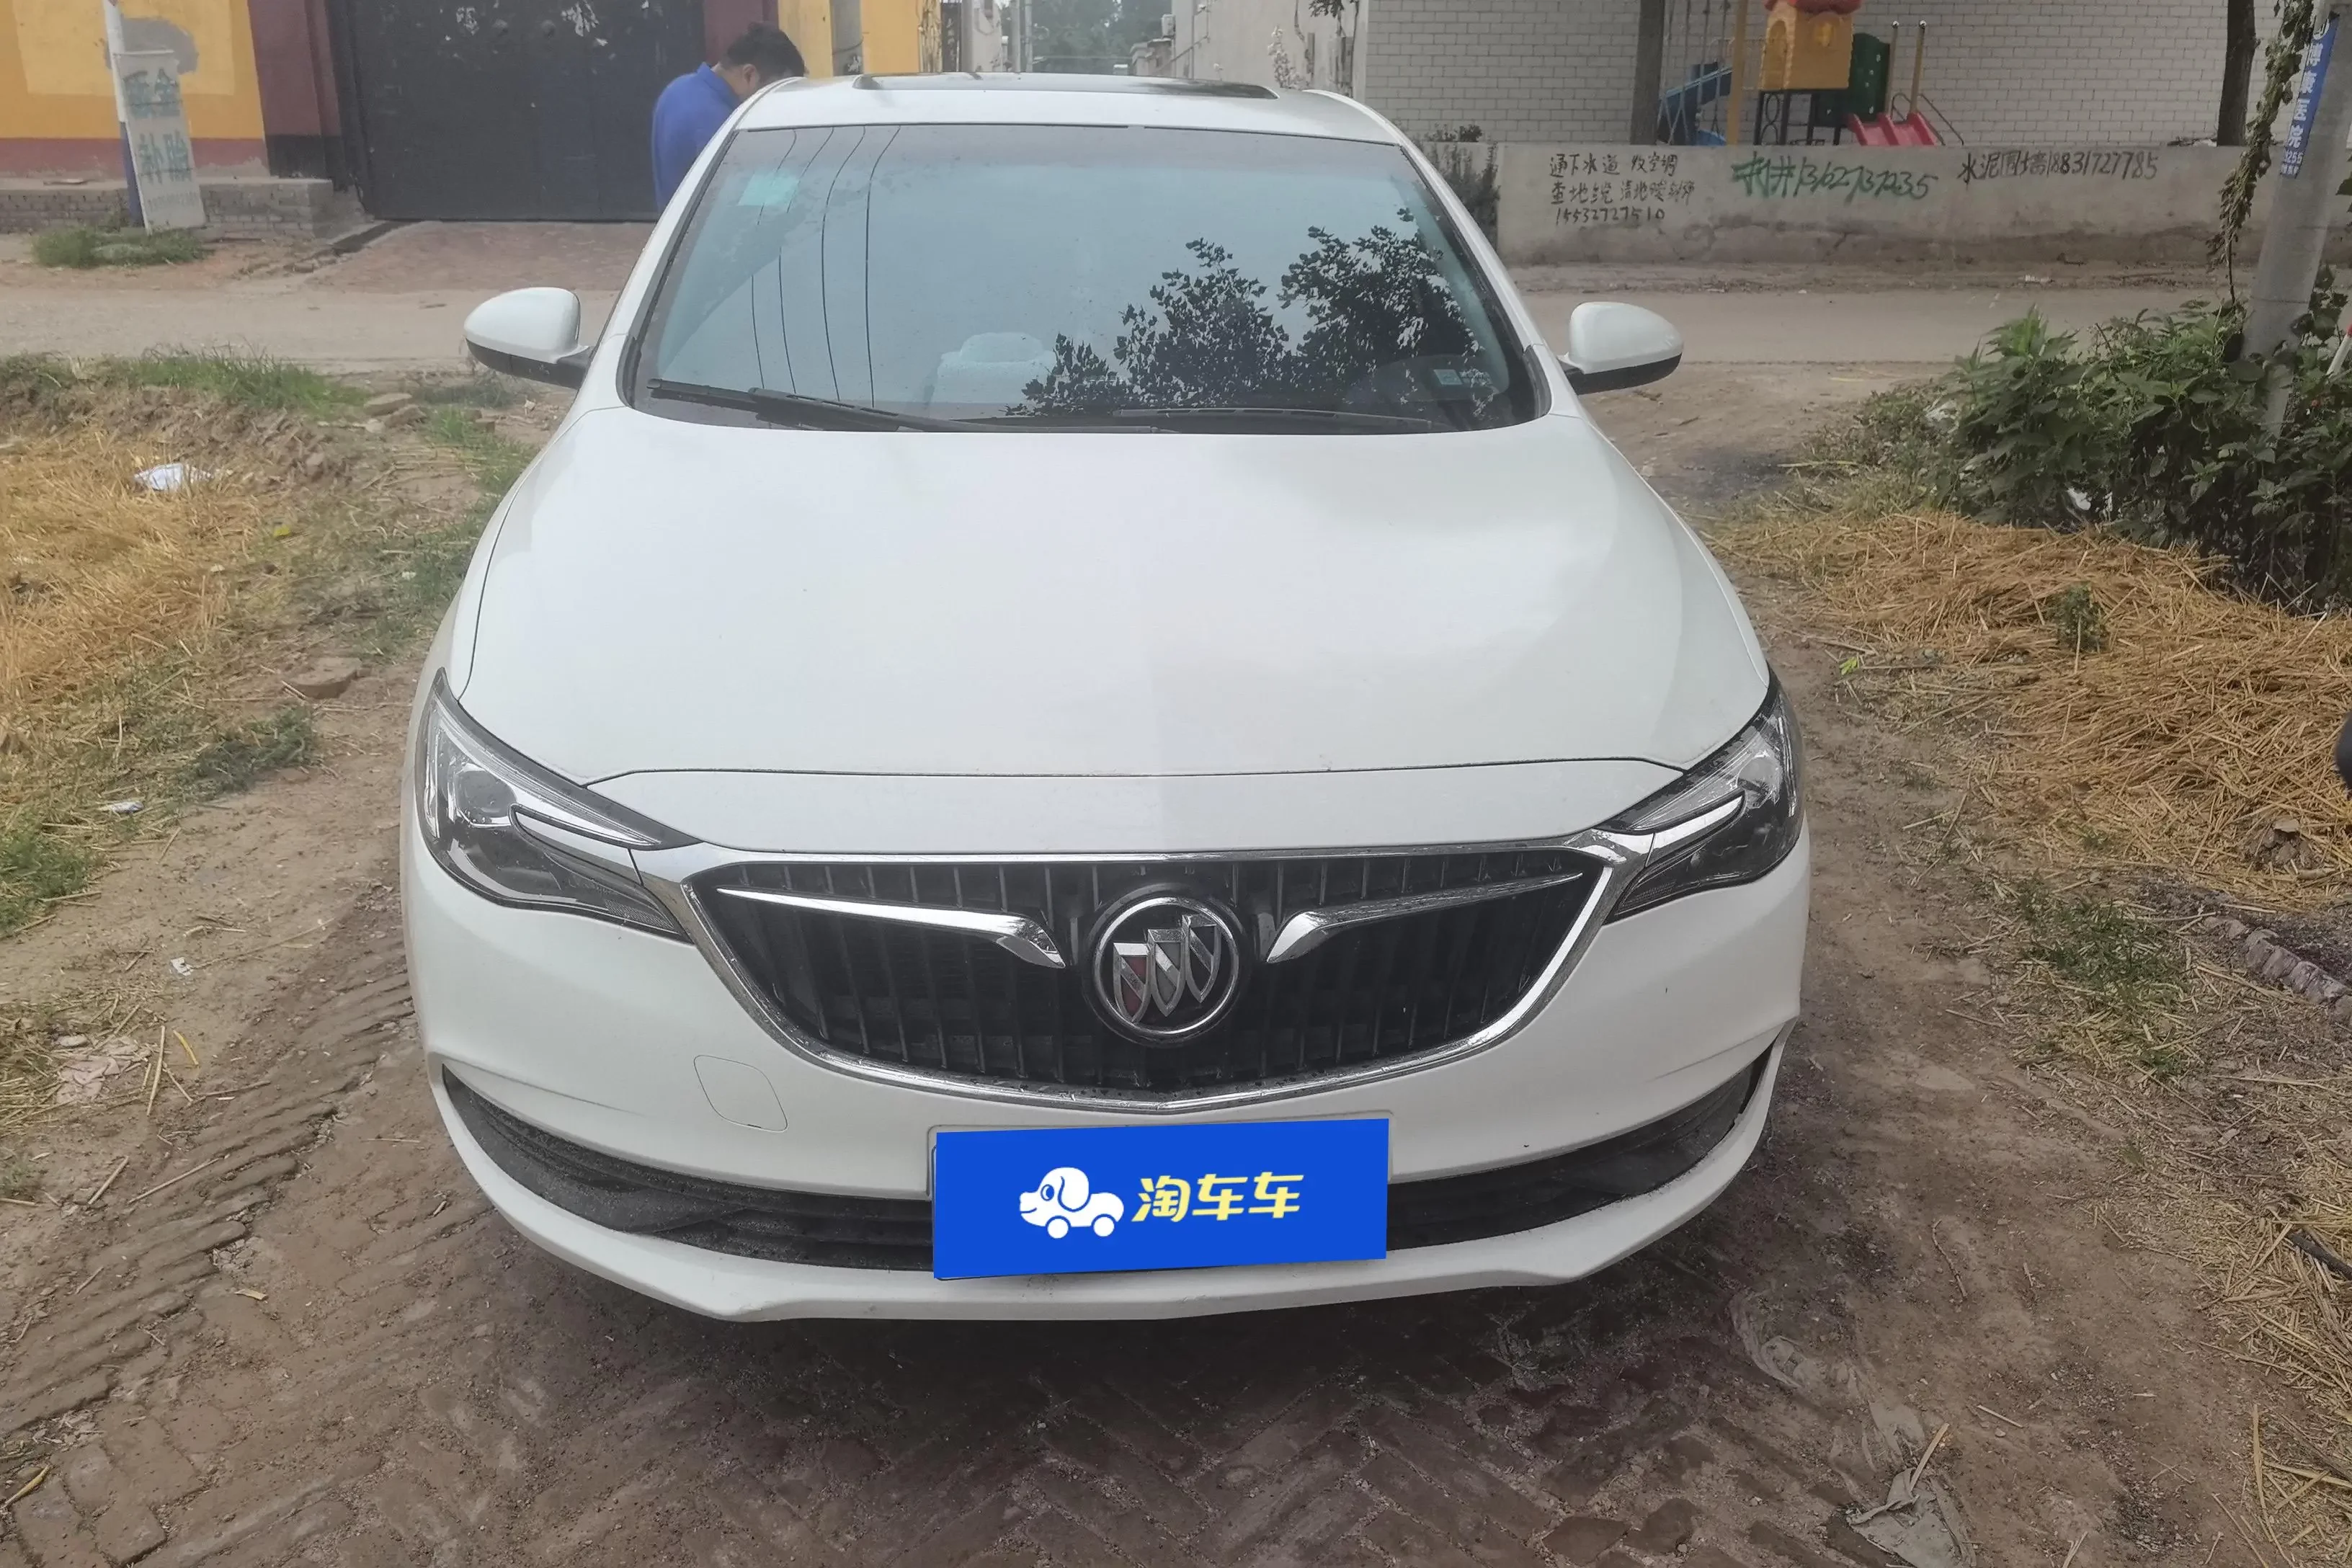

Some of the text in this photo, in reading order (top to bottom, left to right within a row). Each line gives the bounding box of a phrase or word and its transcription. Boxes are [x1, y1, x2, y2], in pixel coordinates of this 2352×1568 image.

[1549, 151, 1678, 178] 通下水道 收空调
[1556, 206, 1665, 226] 15532727510
